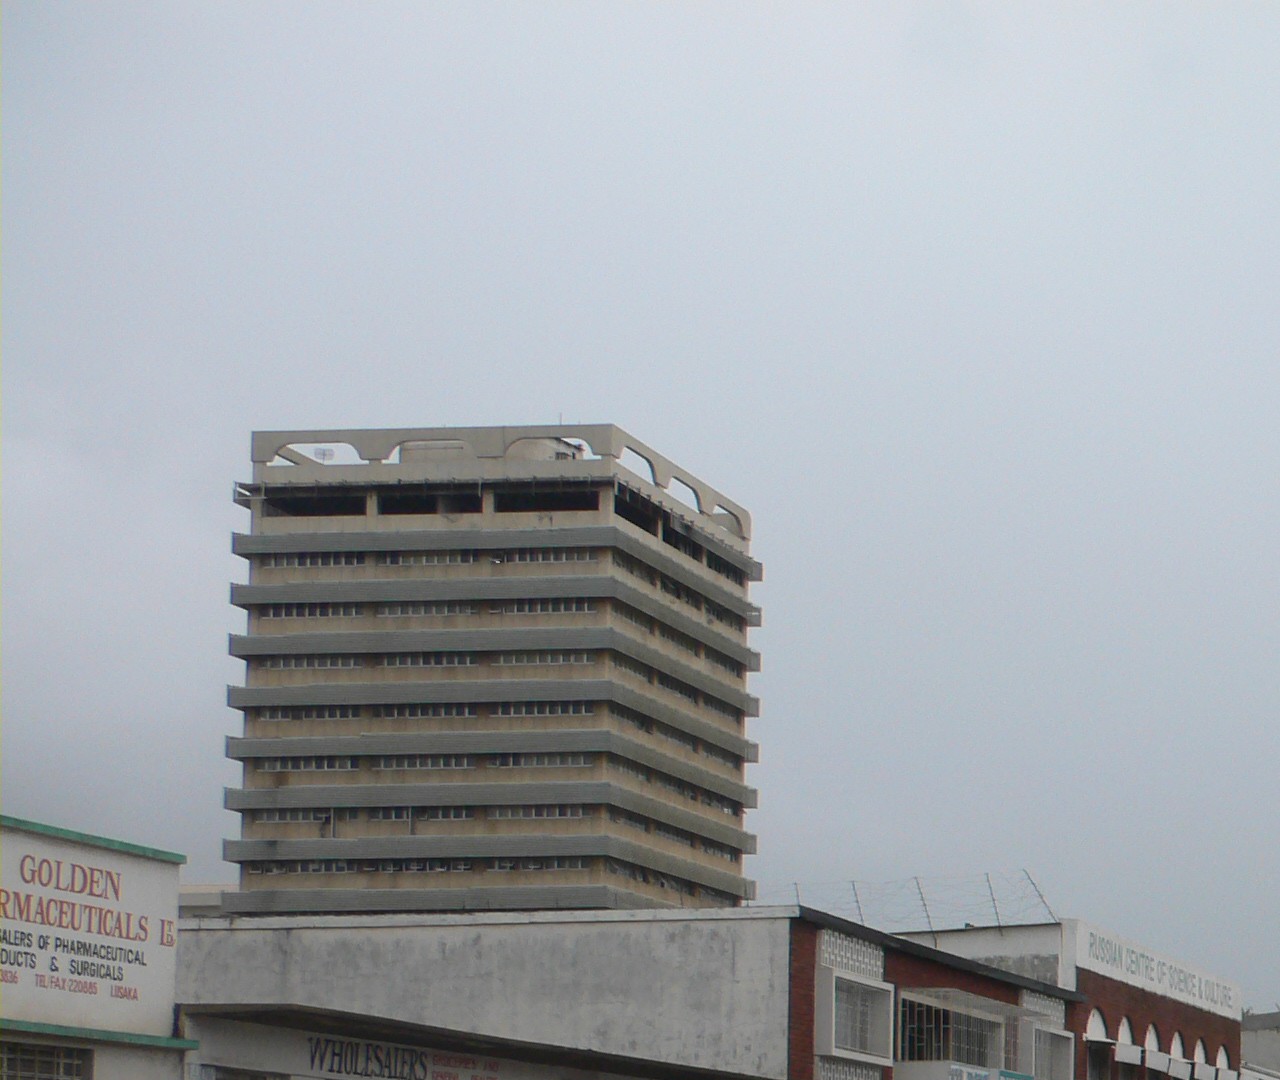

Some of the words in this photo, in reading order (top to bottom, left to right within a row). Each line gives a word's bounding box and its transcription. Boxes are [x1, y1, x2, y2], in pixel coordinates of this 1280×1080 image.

[20, 854, 122, 901] GOLDEN
[38, 935, 50, 951] OF
[55, 937, 147, 966] PHARMACEUTICAL
[50, 956, 59, 972] &
[70, 959, 124, 982] SURGICALS
[1089, 932, 1123, 970] RUSSIAN
[1126, 947, 1155, 982] CENTRE
[1157, 960, 1167, 985] OF
[1168, 964, 1197, 998] SCIENCE
[1204, 979, 1234, 1009] CULTURE
[111, 985, 138, 1001] LUSAKA
